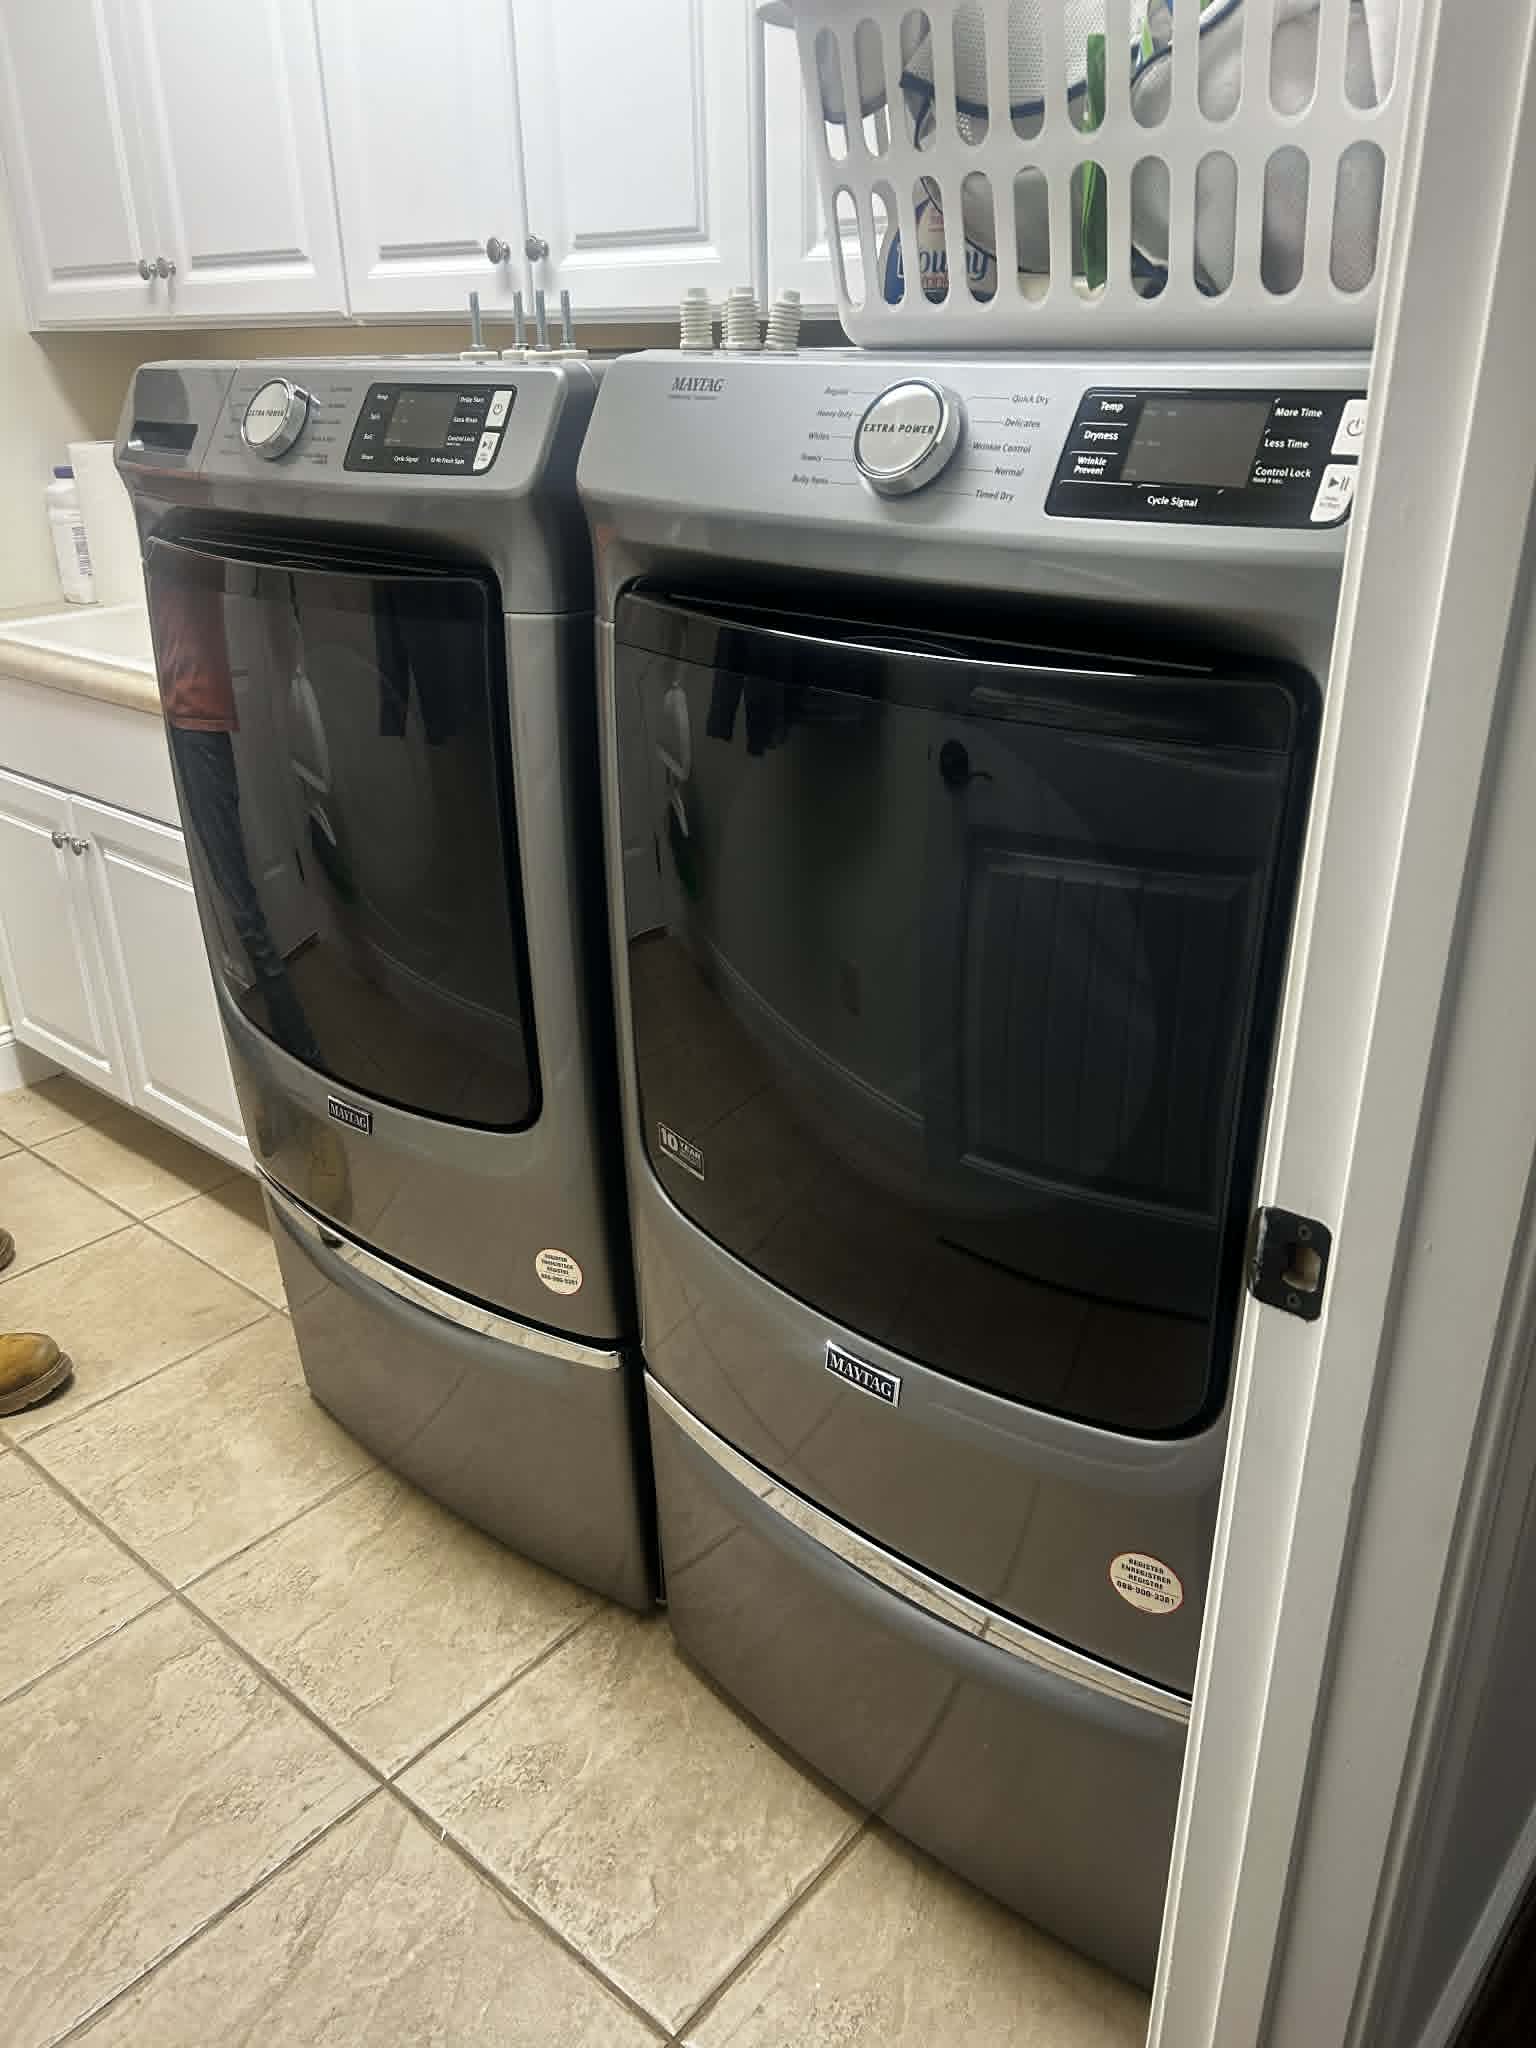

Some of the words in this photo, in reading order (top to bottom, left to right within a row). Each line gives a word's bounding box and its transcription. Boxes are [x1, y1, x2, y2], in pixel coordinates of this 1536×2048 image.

[671, 376, 726, 393] MAYTAG
[1100, 400, 1124, 413] Temp
[1274, 407, 1298, 417] More
[1301, 407, 1323, 418] Time
[863, 423, 896, 433] EXTRA
[897, 423, 935, 434] POWER
[1004, 417, 1041, 428] Delicates
[1083, 430, 1119, 442] Dryness
[1002, 442, 1032, 454] Control
[1263, 438, 1285, 449] Less
[1287, 439, 1310, 449] Time
[1077, 456, 1107, 466] Wrinkle
[994, 465, 1025, 477] Normal
[1073, 465, 1104, 476] Prevent
[1255, 466, 1288, 478] Control
[1289, 467, 1312, 479] Lock
[1000, 491, 1015, 502] Dry
[1147, 495, 1170, 507] Cycle
[1170, 496, 1199, 509] Signal
[330, 1102, 367, 1129] MAYTAG
[660, 1127, 679, 1152] 10
[829, 1352, 892, 1399] MAYTAG
[1128, 1558, 1164, 1575] REGISTER
[1121, 1562, 1172, 1585] ENREGISTRER
